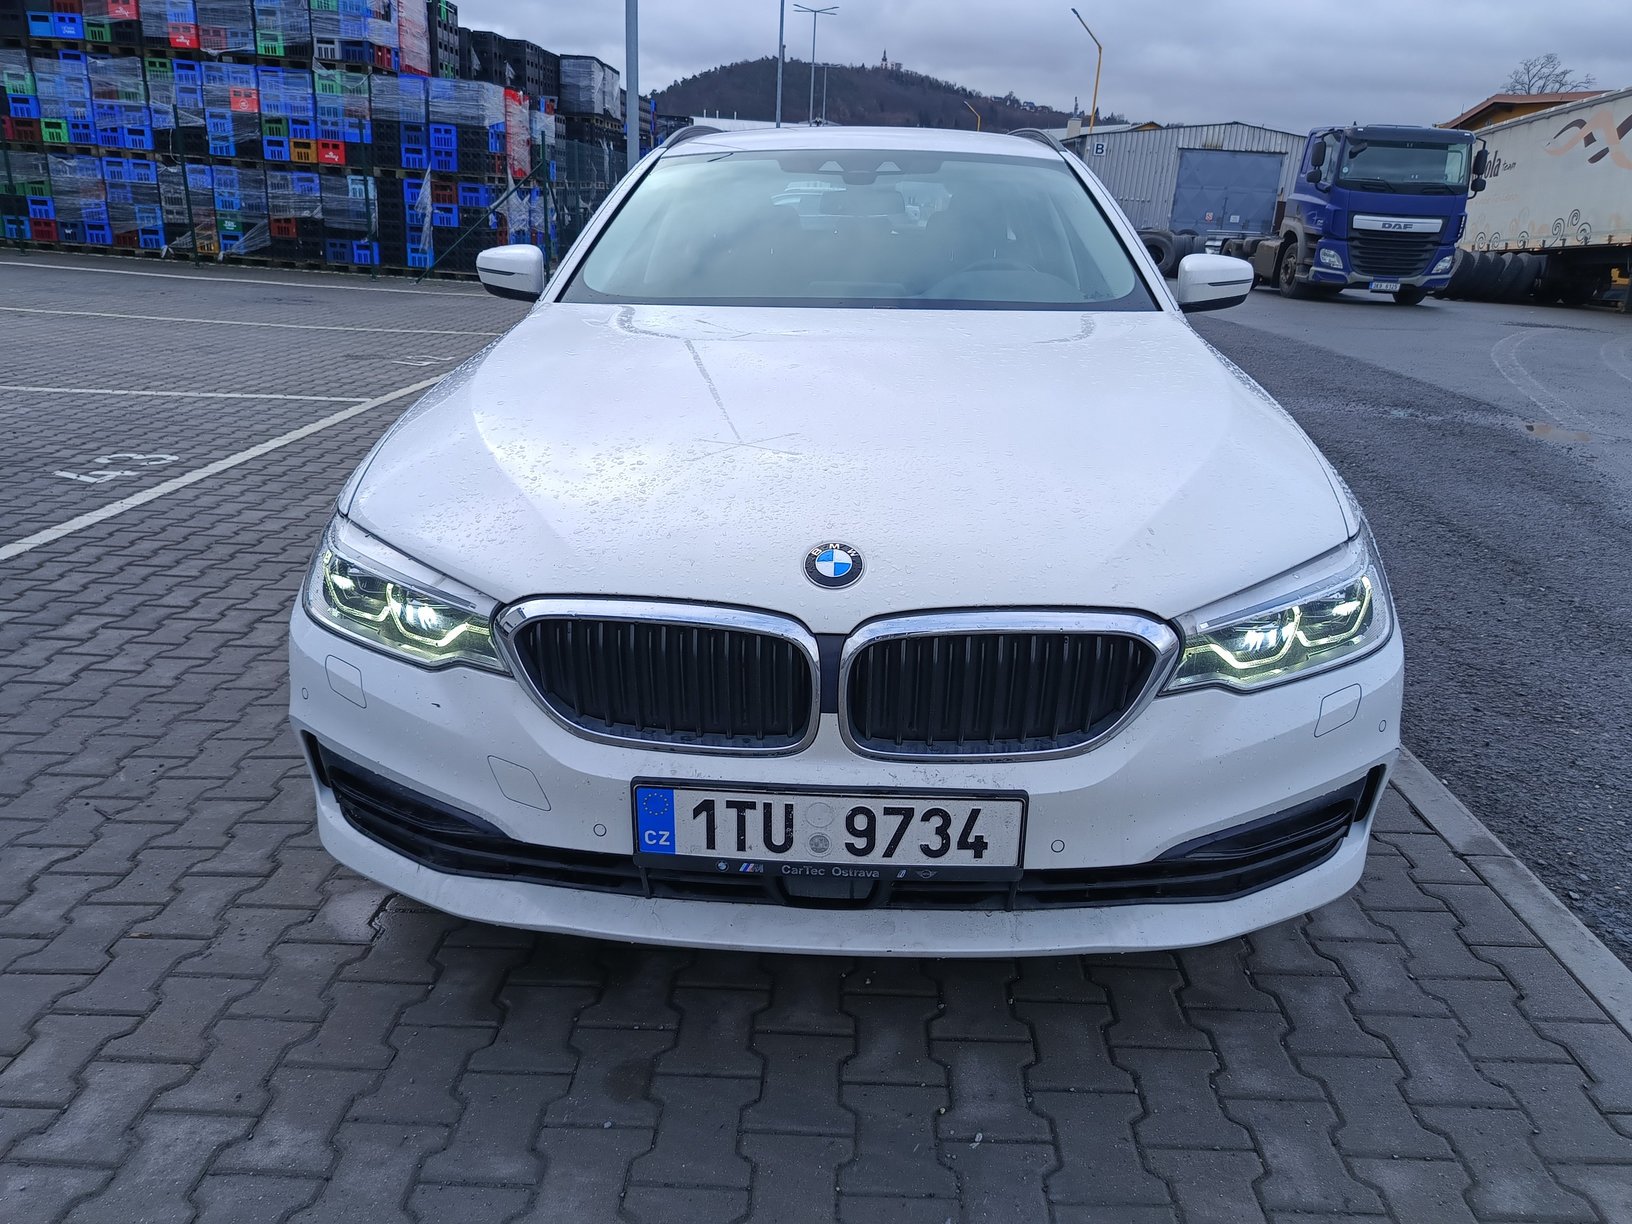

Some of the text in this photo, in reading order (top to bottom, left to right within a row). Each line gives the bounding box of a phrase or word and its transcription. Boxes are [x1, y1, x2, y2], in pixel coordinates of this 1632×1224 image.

[1095, 143, 1105, 155] B
[1381, 222, 1414, 230] DAF
[811, 543, 859, 557] BMW
[693, 799, 988, 859] 1TU 9734
[644, 830, 670, 845] CZ
[781, 864, 825, 876] CarTec
[831, 866, 880, 878] Ostrava
